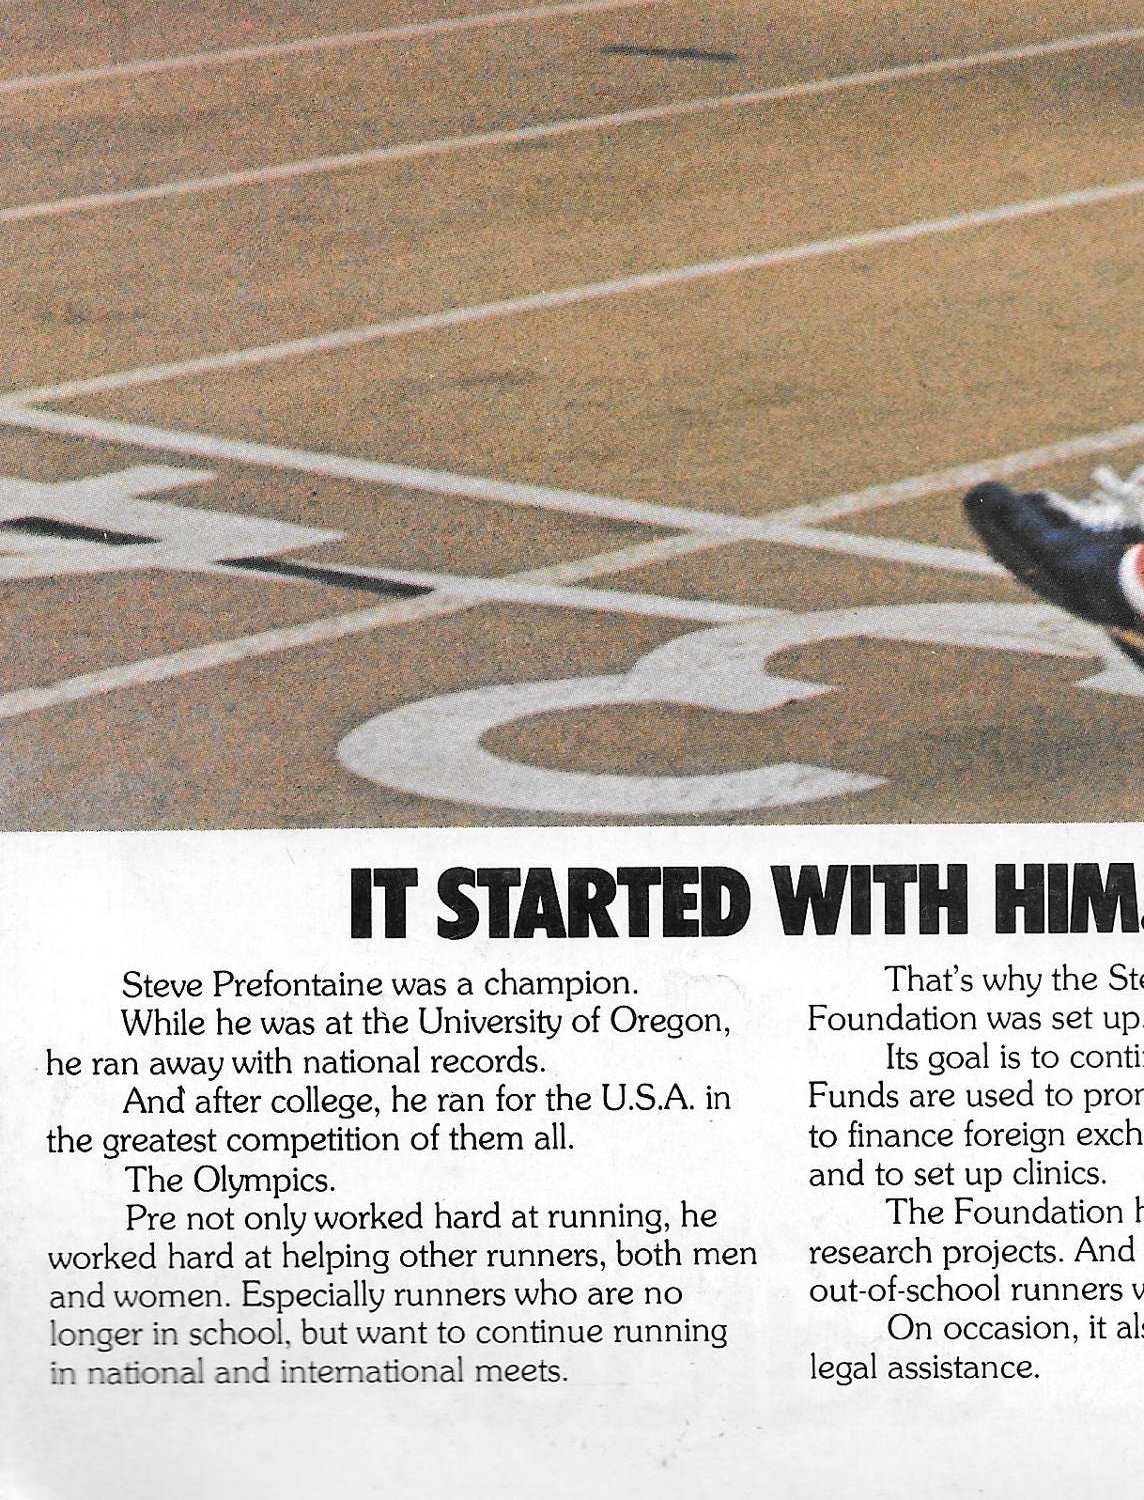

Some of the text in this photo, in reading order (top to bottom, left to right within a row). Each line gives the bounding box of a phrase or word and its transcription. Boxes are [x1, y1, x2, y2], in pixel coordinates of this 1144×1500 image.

[350, 867, 419, 939] IT
[436, 865, 752, 941] STARTED
[769, 863, 969, 936] WITH
[122, 967, 639, 1002] Steve Prefontaine was a champion.
[884, 963, 974, 993] That's
[982, 963, 1043, 998] why
[1051, 963, 1098, 992] the
[120, 1004, 730, 1041] While he was at the University of Oregon,
[807, 1002, 978, 1031] Foundation
[986, 1011, 1042, 1031] was
[1051, 1006, 1094, 1030] set
[45, 1044, 546, 1082] he ran away with national records.
[886, 1042, 919, 1071] Its
[928, 1041, 990, 1076] goal
[1000, 1043, 1021, 1070] is
[1030, 1045, 1060, 1069] to
[808, 1079, 899, 1109] Funds
[909, 1088, 956, 1108] are
[965, 1078, 1035, 1108] used
[1044, 1083, 1074, 1107] to
[45, 1121, 574, 1160] the greatest competition of them all.
[808, 1124, 838, 1149] to
[847, 1119, 954, 1148] finance
[963, 1118, 1065, 1153] foreign
[124, 1164, 336, 1200] The Olympics.
[809, 1156, 1107, 1193] and to set up clinics.
[125, 1199, 718, 1237] Pre not only worked hard at running, he
[885, 1196, 944, 1225] The
[954, 1195, 1123, 1225] Foundation
[47, 1238, 758, 1276] worked hard at helping other runners, both men
[809, 1273, 1001, 1303] out-of-school
[1010, 1282, 1123, 1302] runners
